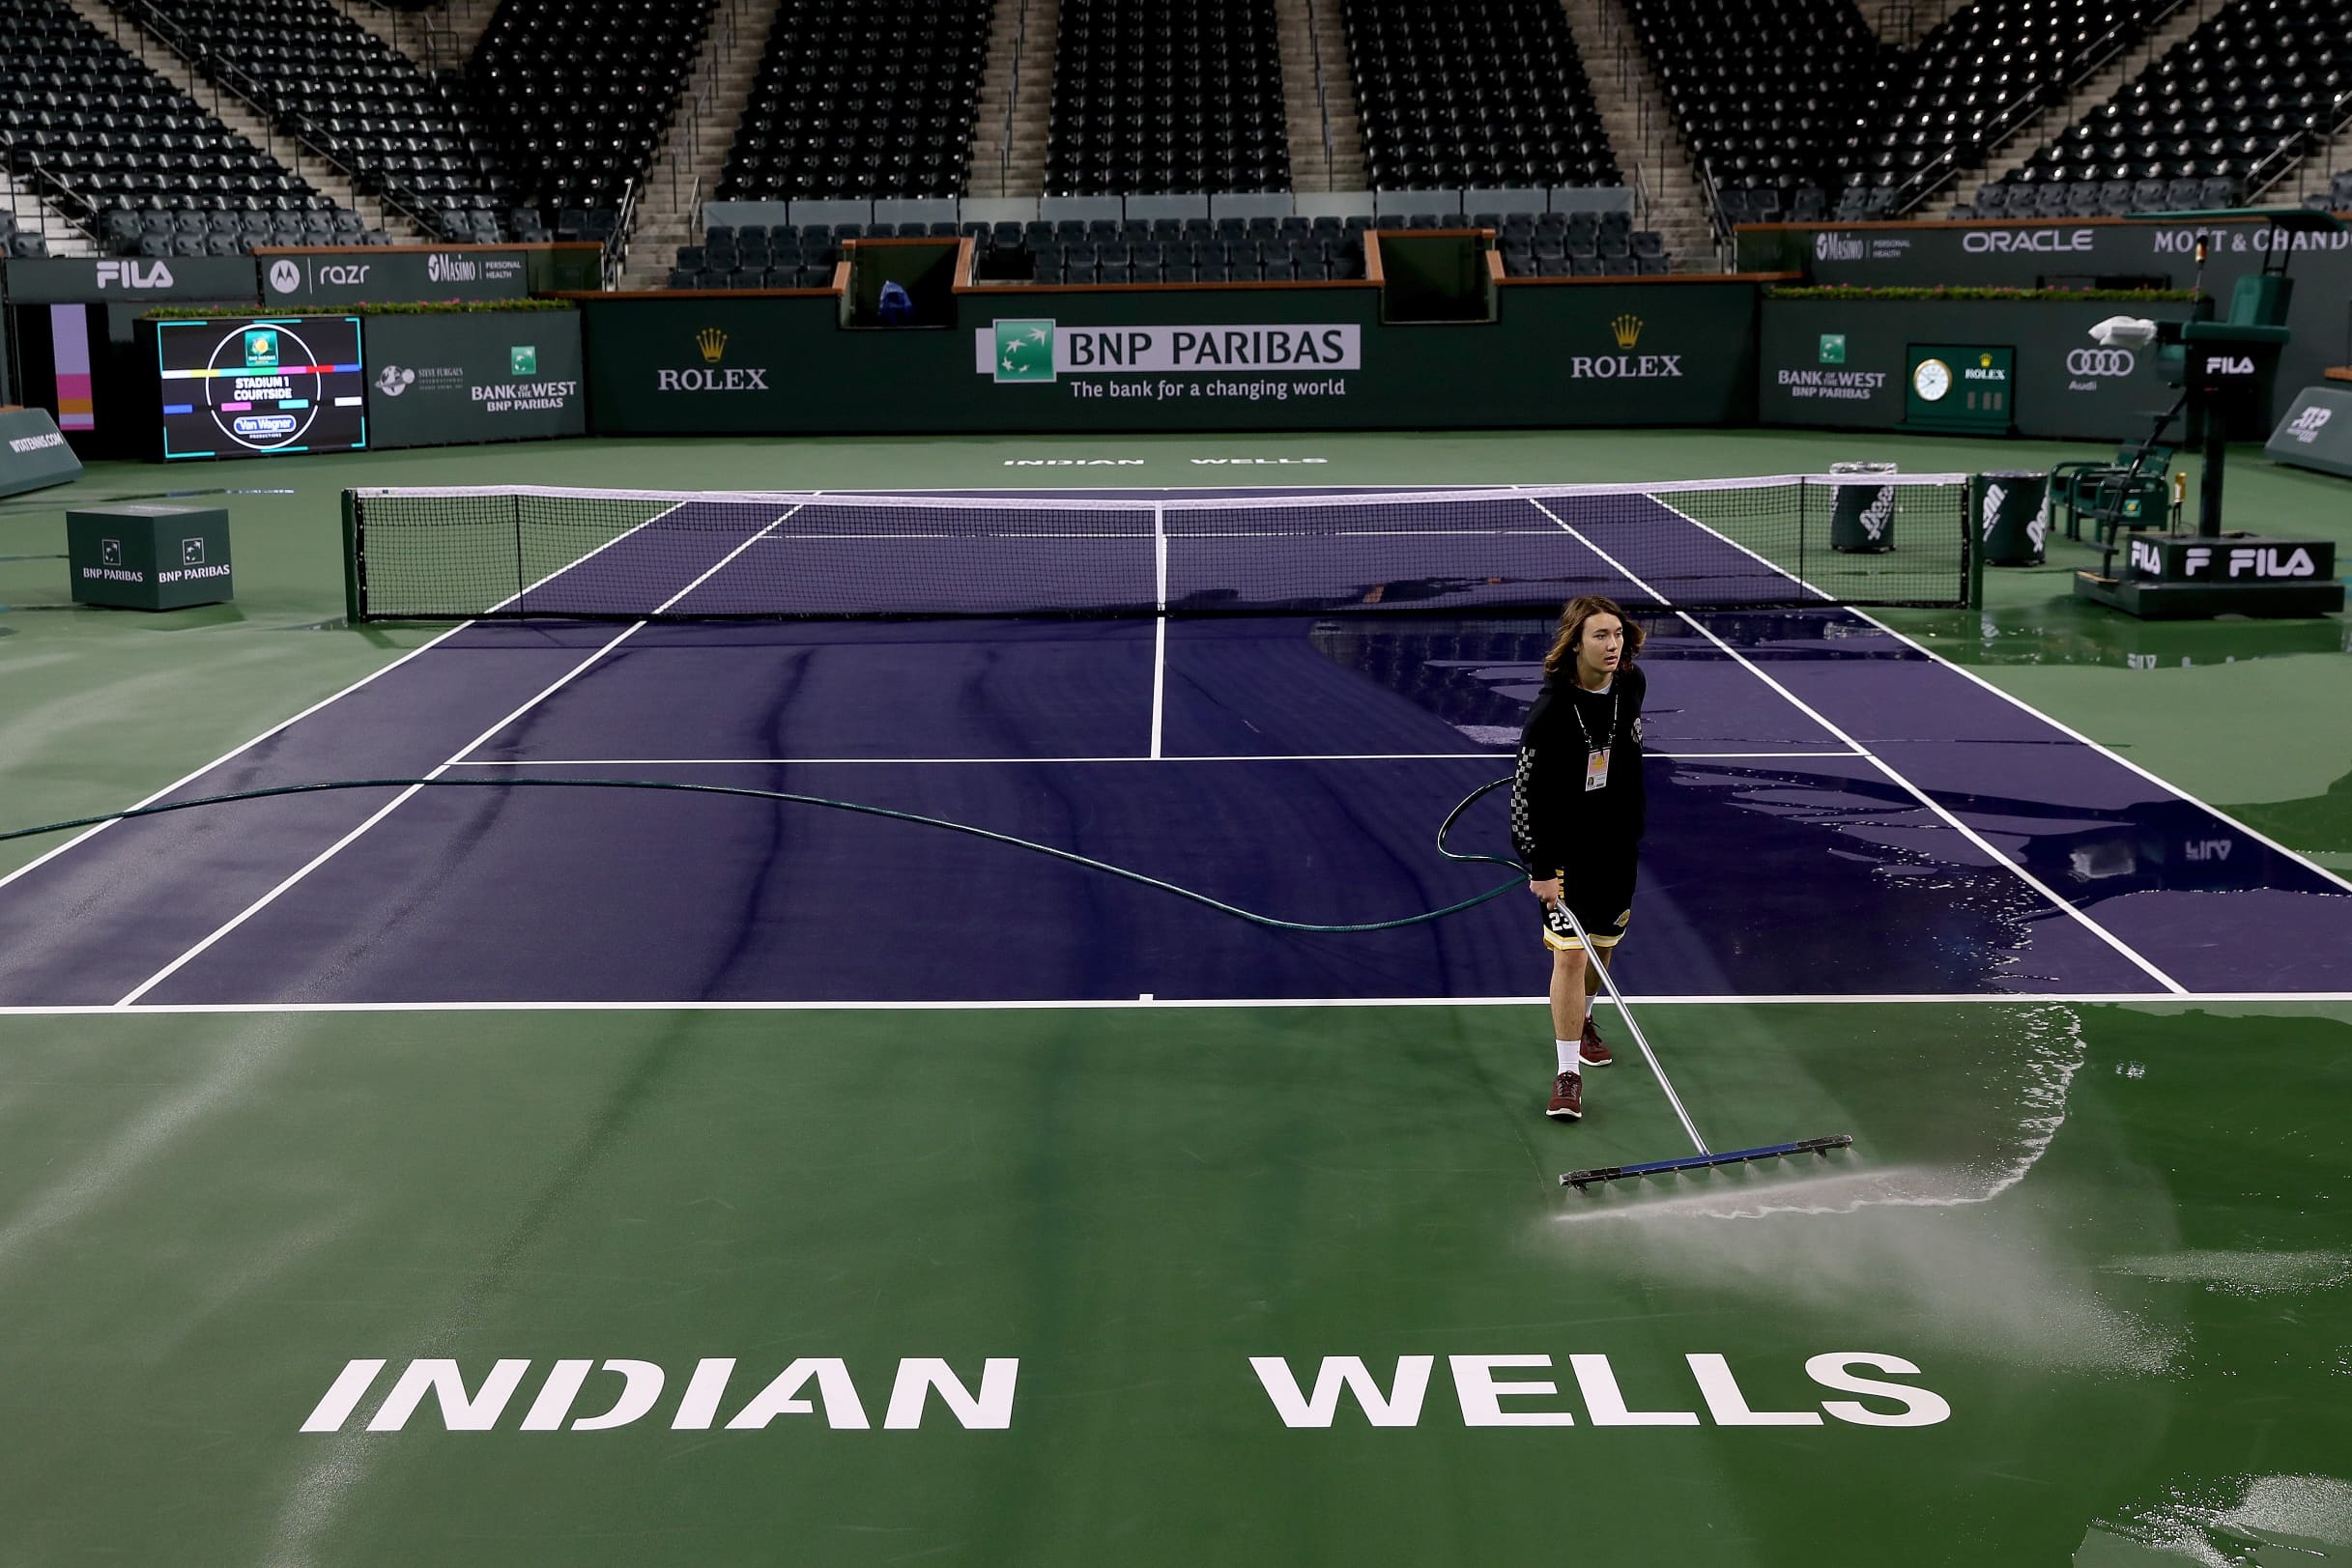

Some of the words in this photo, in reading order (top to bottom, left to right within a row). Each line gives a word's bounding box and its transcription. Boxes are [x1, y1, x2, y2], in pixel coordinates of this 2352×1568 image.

[1873, 239, 1910, 248] PERSONAL
[1963, 229, 2093, 252] ORACLE
[2154, 227, 2226, 252] MOT
[2232, 234, 2246, 251] &
[97, 261, 173, 288] FILA
[485, 261, 521, 270] PERSONAL
[321, 266, 369, 284] razr
[1070, 332, 1152, 365] BNP
[1172, 329, 1345, 365] PARIBAS
[1570, 356, 1682, 378] ROLEX
[2207, 357, 2254, 373] FILA
[235, 376, 283, 388] STADIUM
[284, 376, 290, 387] 1
[658, 369, 768, 390] ROLEX
[1779, 370, 1821, 385] BANK
[1837, 372, 1885, 389] WEST
[1965, 369, 2004, 380] ROLEX
[234, 387, 293, 401] COURTSIDE
[471, 385, 516, 400] BANK
[531, 382, 576, 397] WEST
[1071, 382, 1103, 397] The
[1110, 381, 1152, 396] bank
[1158, 380, 1184, 400] for
[1190, 384, 1200, 396] a
[1207, 380, 1287, 400] changing
[1293, 379, 1345, 395] world
[1793, 386, 1817, 396] BNP
[1820, 387, 1871, 400] PARIBAS
[2069, 381, 2097, 390] Audi
[487, 401, 511, 412] BNP
[514, 397, 564, 411] PARIBAS
[241, 419, 258, 430] Van
[2132, 541, 2161, 574] FILA
[2186, 549, 2211, 576] F
[2229, 548, 2314, 577] FILA
[83, 568, 101, 578] BNP
[104, 569, 143, 582] PARIBAS
[159, 571, 182, 583] BNP
[184, 563, 231, 581] PARIBAS
[1549, 911, 1573, 931] 23
[300, 1358, 1018, 1432] INDIAN
[1248, 1353, 1950, 1427] WELLS
